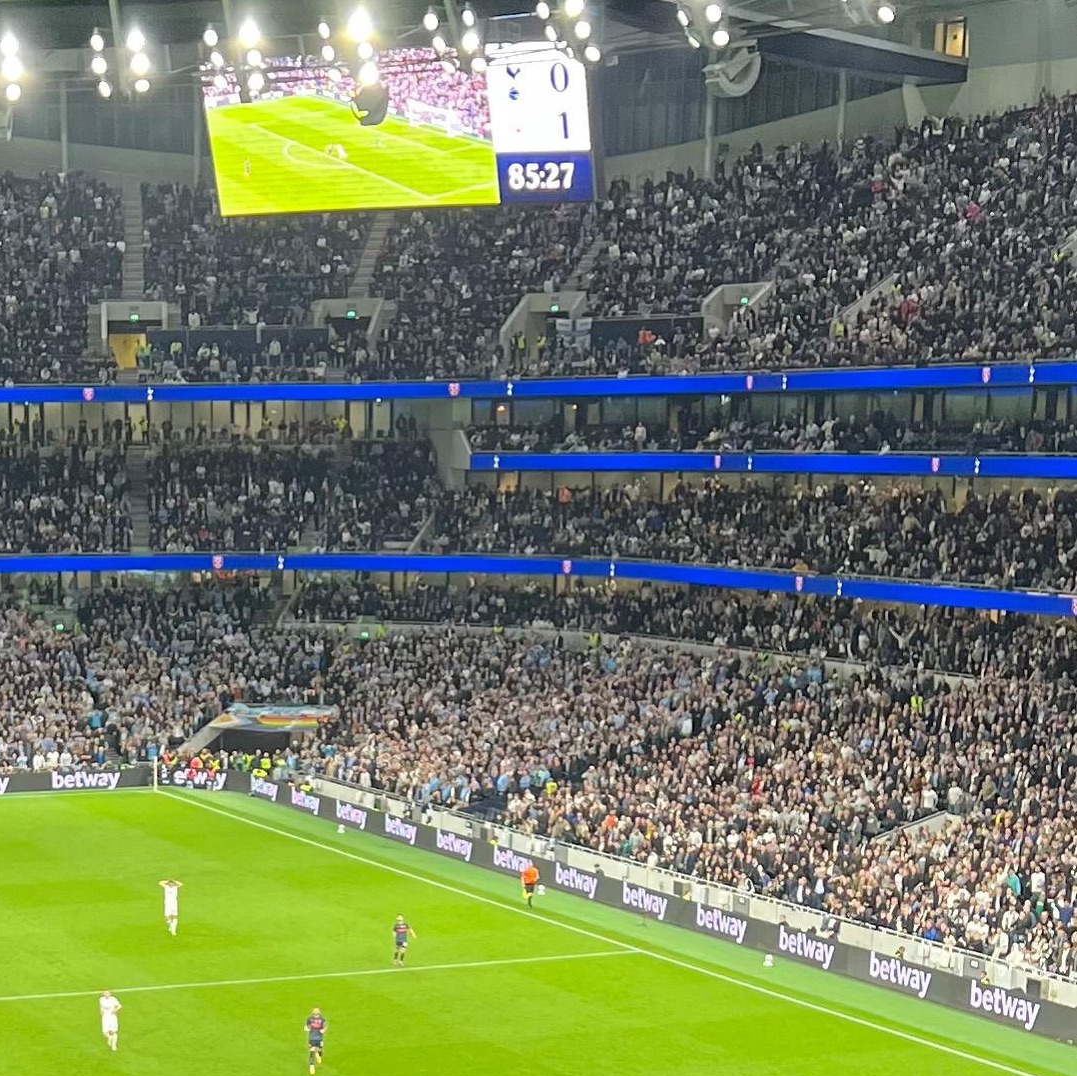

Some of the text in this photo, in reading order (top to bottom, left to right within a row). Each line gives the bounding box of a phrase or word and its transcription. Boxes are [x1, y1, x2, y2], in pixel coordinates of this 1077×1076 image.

[550, 62, 569, 92] 0
[558, 111, 569, 139] 1
[507, 162, 575, 190] 85:27
[52, 771, 120, 791] betway
[336, 799, 367, 830] betway
[384, 812, 417, 845] betway
[436, 828, 473, 862] betway
[555, 862, 597, 899] betway
[623, 881, 668, 920] betway
[696, 903, 747, 944] betway
[779, 926, 835, 969] betway
[869, 951, 932, 998] betway
[970, 980, 1041, 1031] betway
